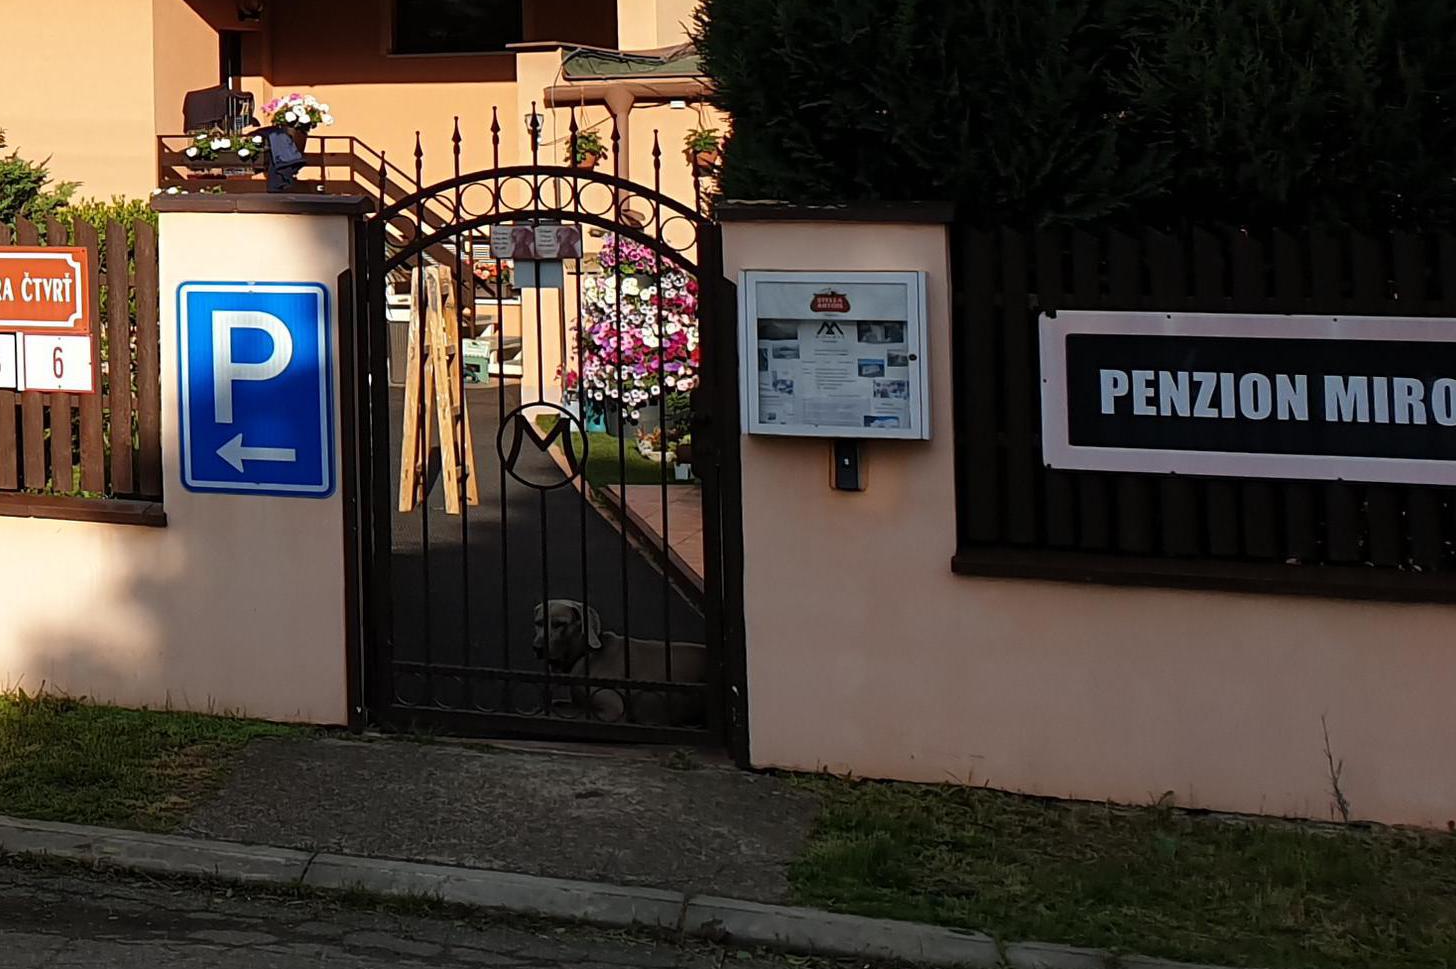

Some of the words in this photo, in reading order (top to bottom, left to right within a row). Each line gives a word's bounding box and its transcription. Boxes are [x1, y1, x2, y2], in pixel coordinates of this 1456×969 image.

[21, 272, 72, 303] ČTVRŤ
[53, 346, 64, 379] 6
[212, 310, 293, 424] P
[1100, 369, 1309, 421] PENZION
[1324, 375, 1456, 426] MIRO
